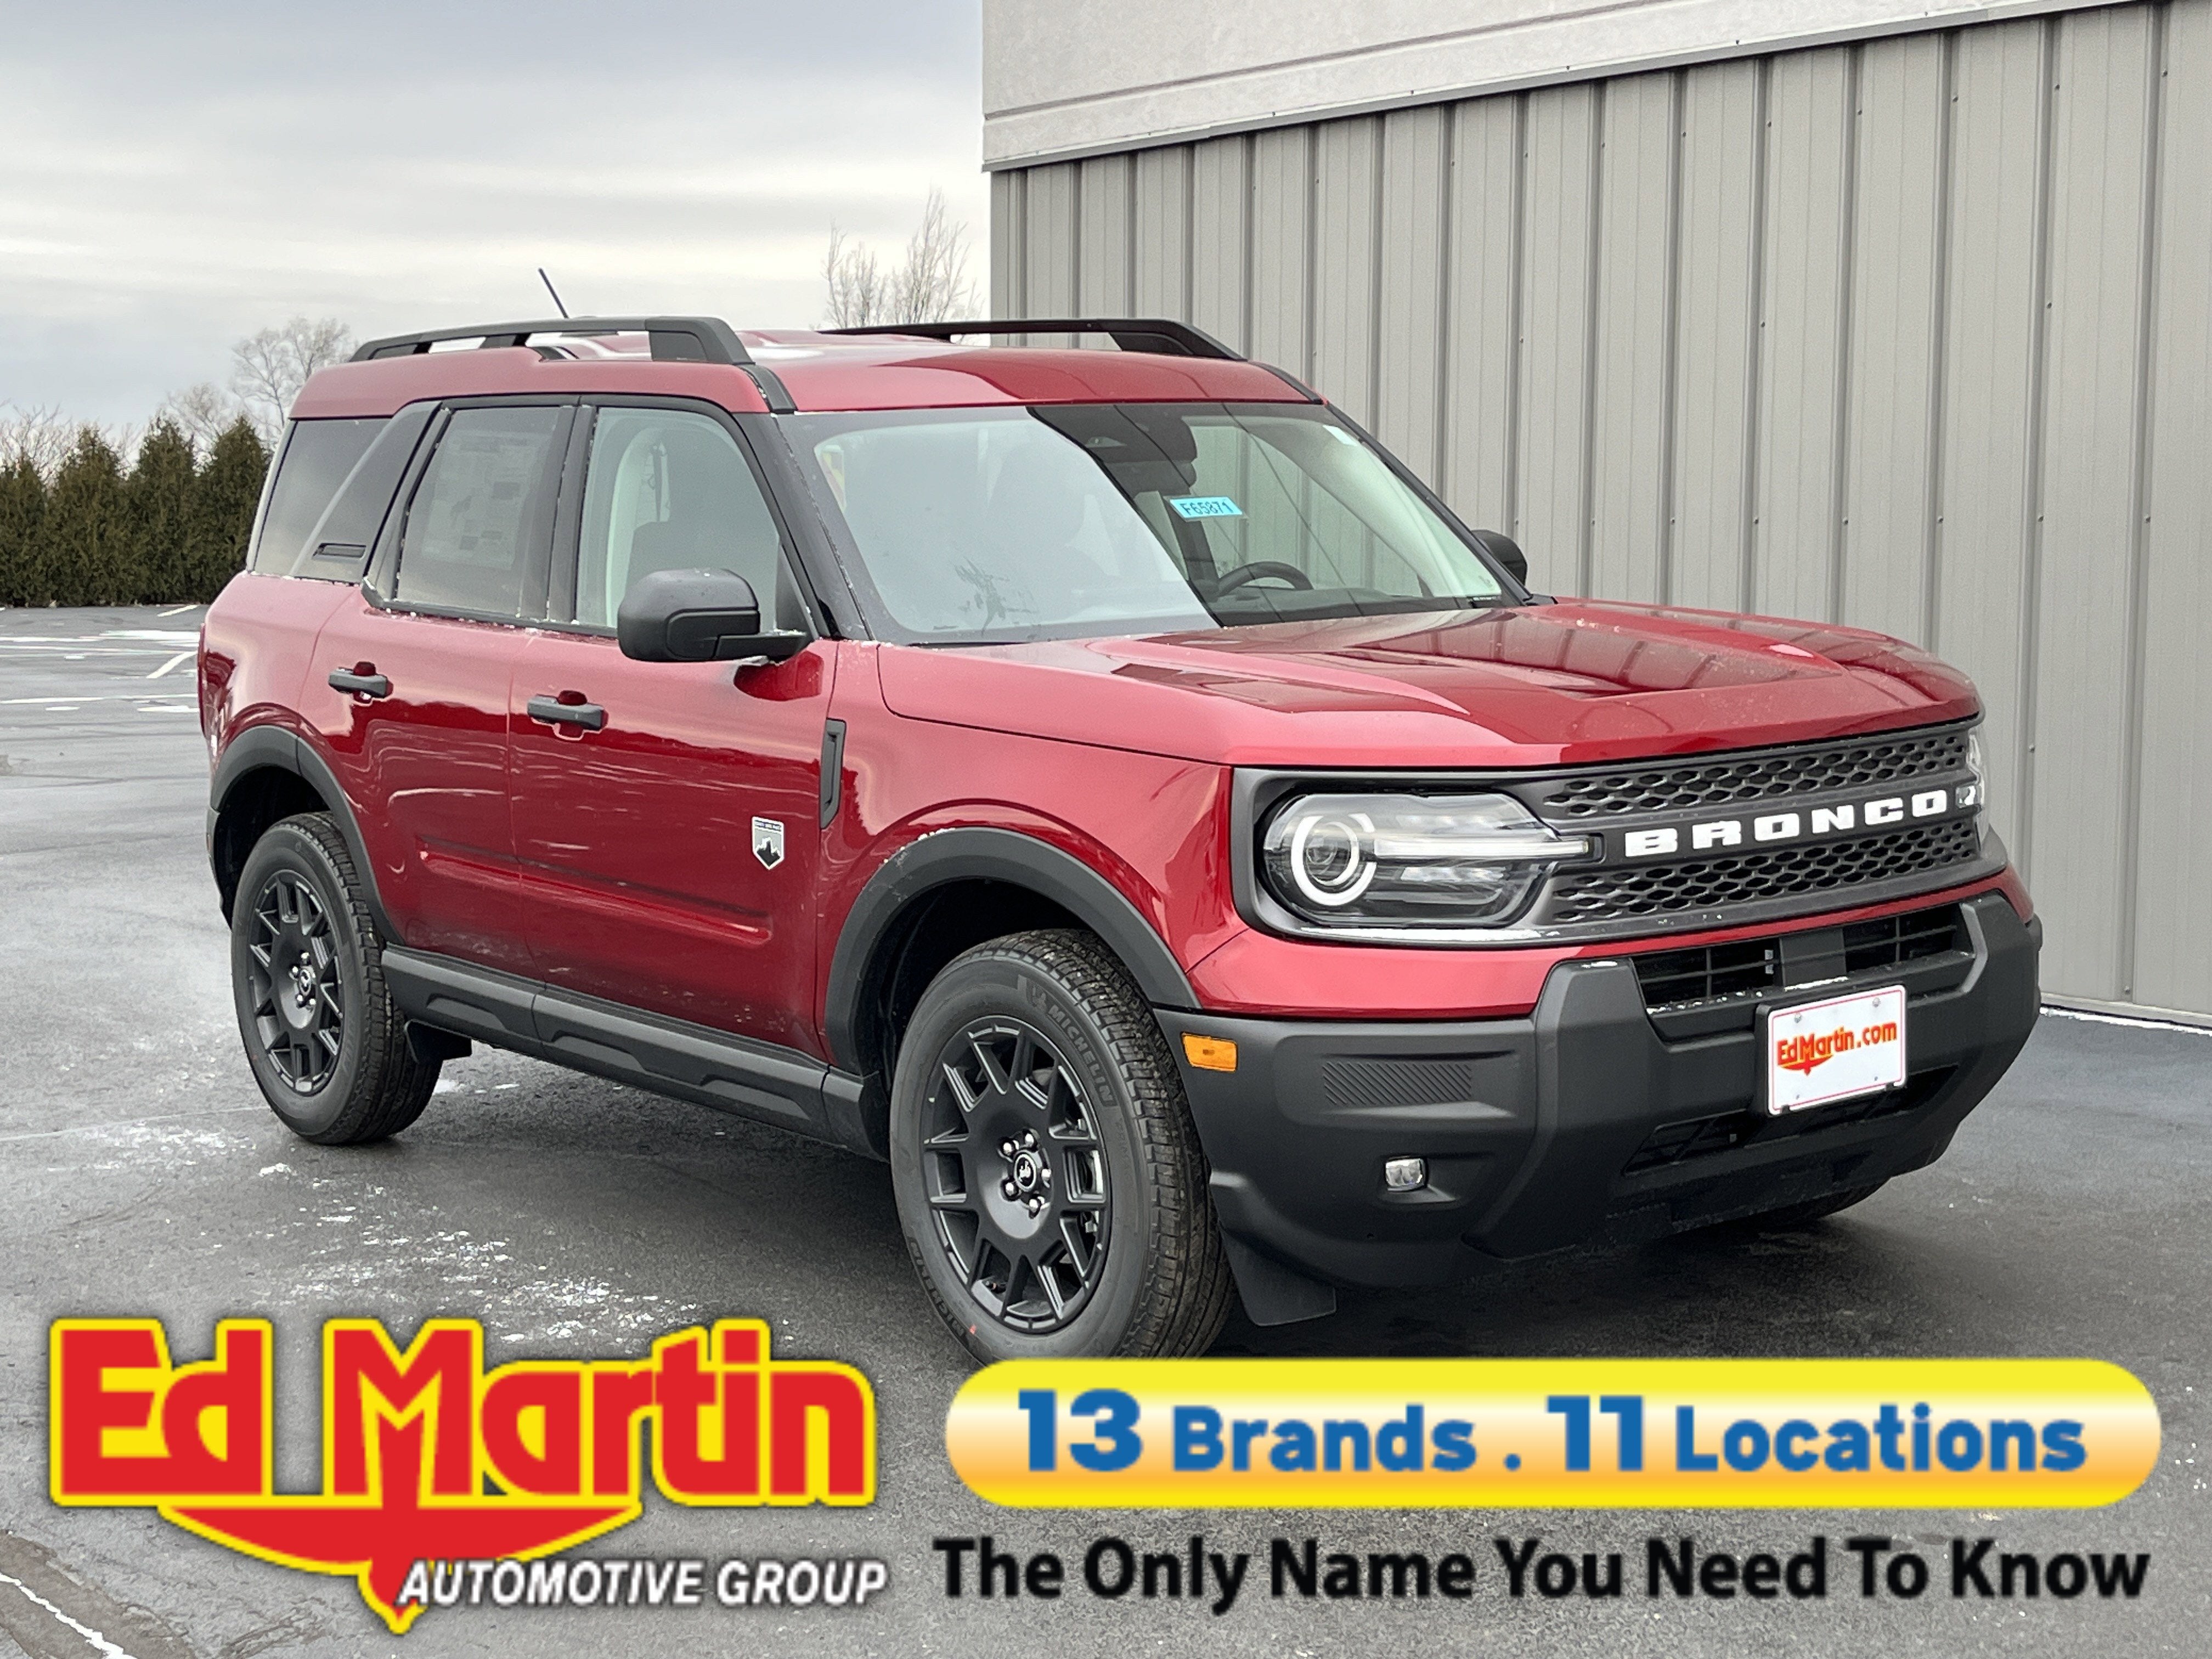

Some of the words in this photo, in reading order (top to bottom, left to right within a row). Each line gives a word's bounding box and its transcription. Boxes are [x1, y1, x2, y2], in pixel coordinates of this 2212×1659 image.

[1180, 501, 1233, 516] F65871
[1624, 788, 1947, 857] BRONCO
[1047, 1004, 1114, 1106] MICHELIN
[1776, 1020, 1898, 1066] EdMartin.com
